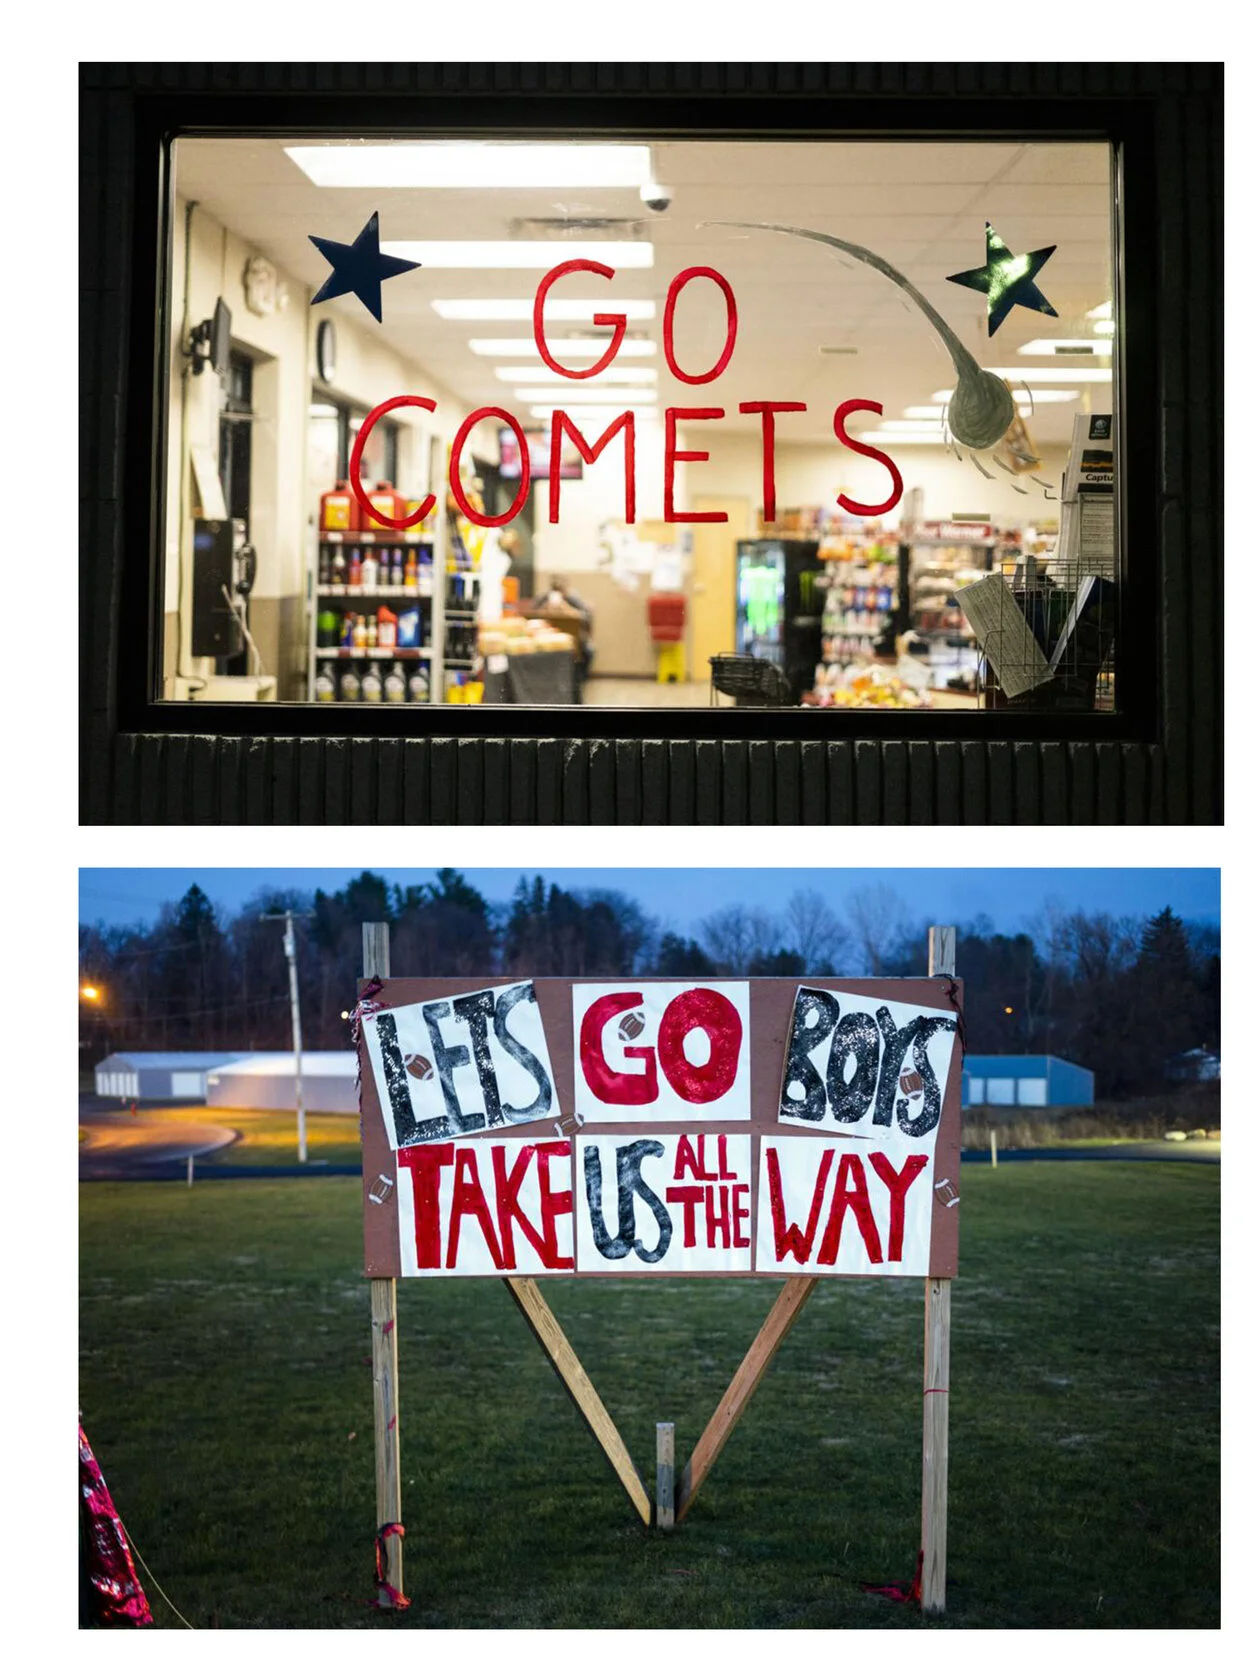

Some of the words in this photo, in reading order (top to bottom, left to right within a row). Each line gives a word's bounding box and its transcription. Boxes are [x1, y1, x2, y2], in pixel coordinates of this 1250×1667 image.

[533, 259, 738, 385] GO
[348, 395, 904, 529] COMETS
[375, 981, 552, 1145] LETS
[580, 988, 743, 1105] GO
[780, 986, 957, 1137] BOYS
[397, 1140, 574, 1270] TAKE
[583, 1139, 673, 1263] US
[666, 1183, 750, 1249] THE
[673, 1133, 737, 1182] ALL
[766, 1147, 929, 1266] WAY
